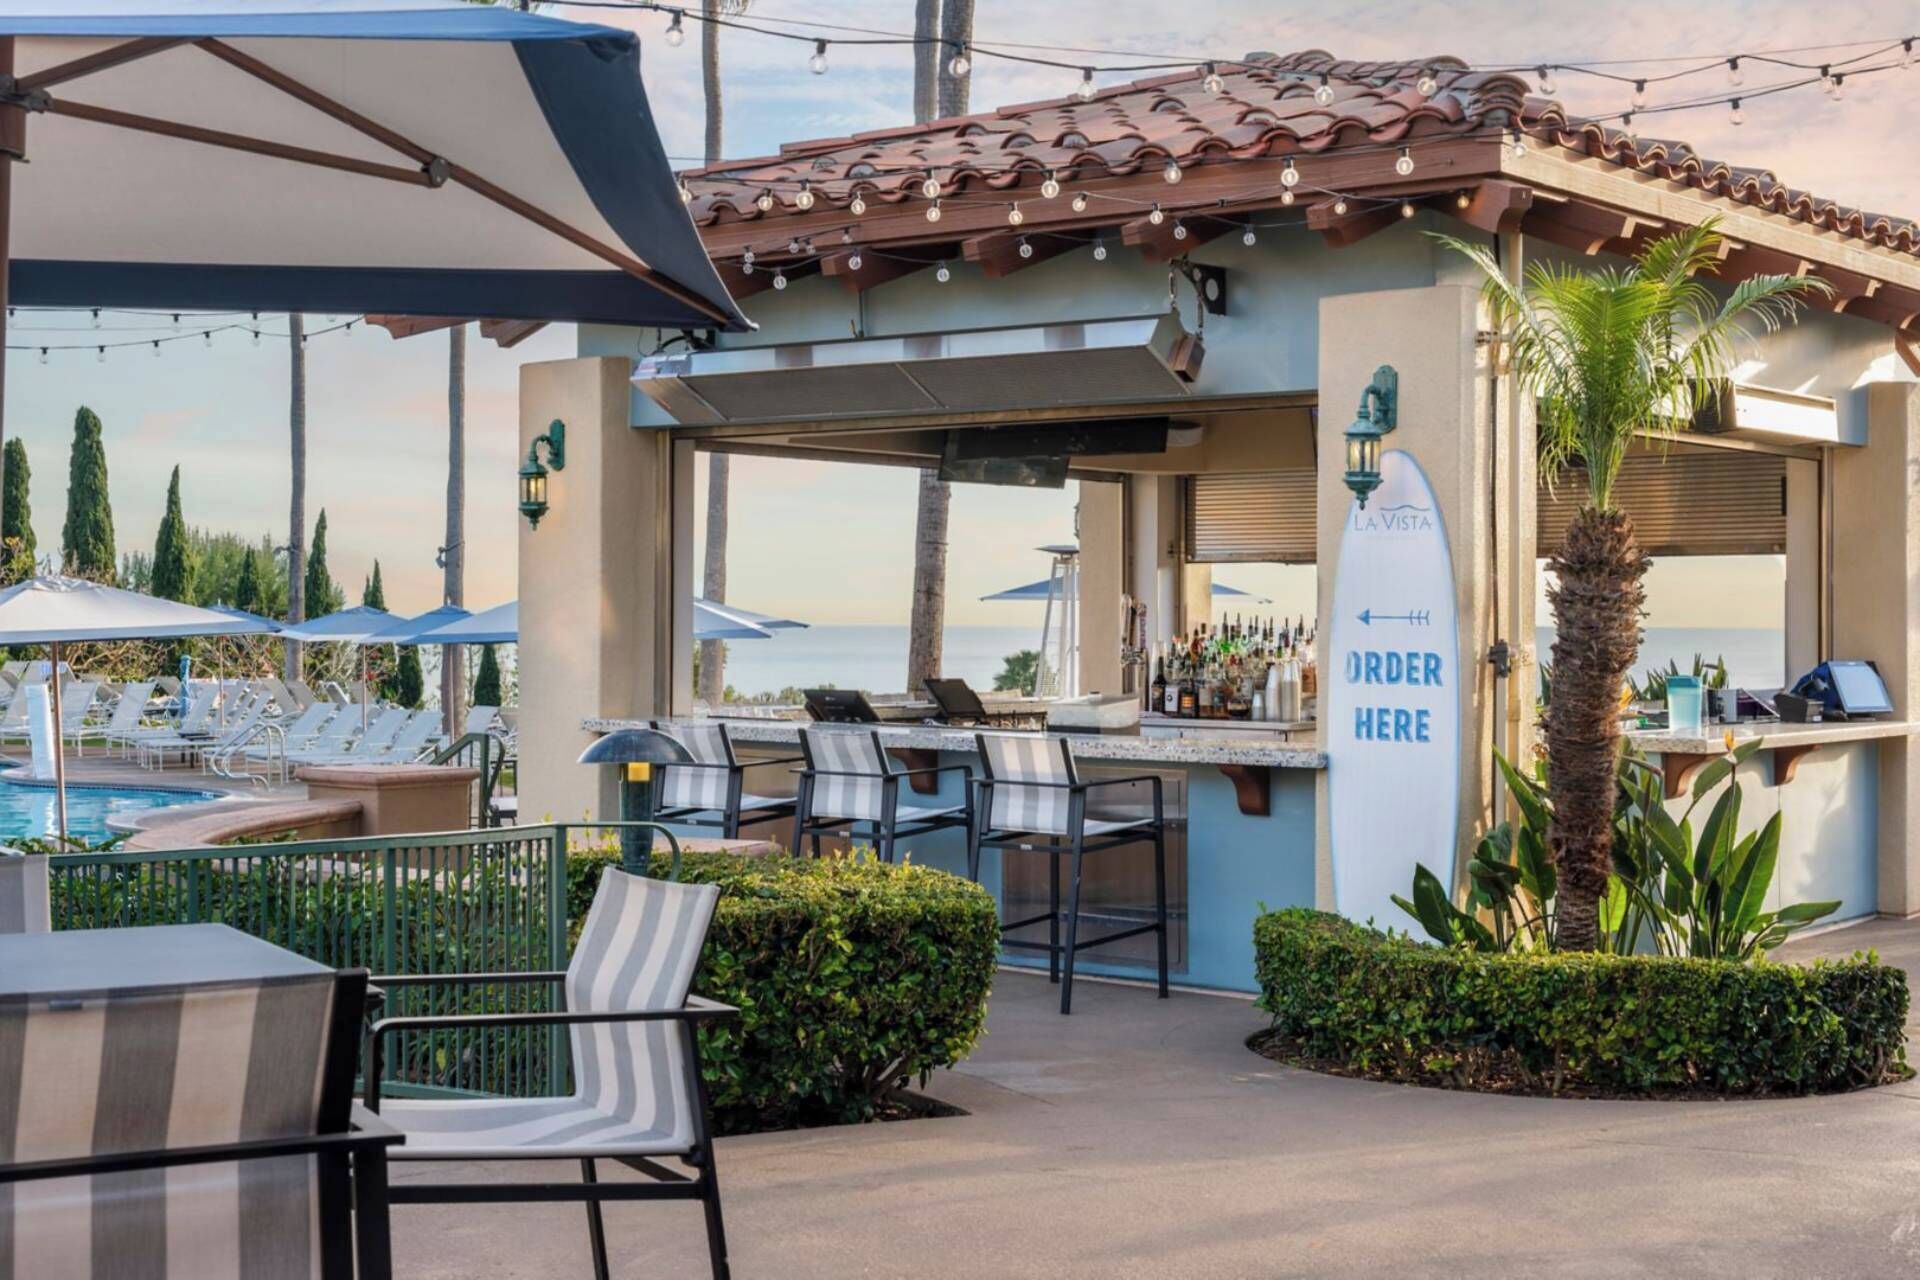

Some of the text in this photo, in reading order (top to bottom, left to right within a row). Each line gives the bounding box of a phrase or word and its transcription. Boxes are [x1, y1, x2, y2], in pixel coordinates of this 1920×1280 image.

[1354, 512, 1432, 531] LA VISTA
[1345, 651, 1443, 687] ORDER
[1355, 707, 1431, 743] HERE
